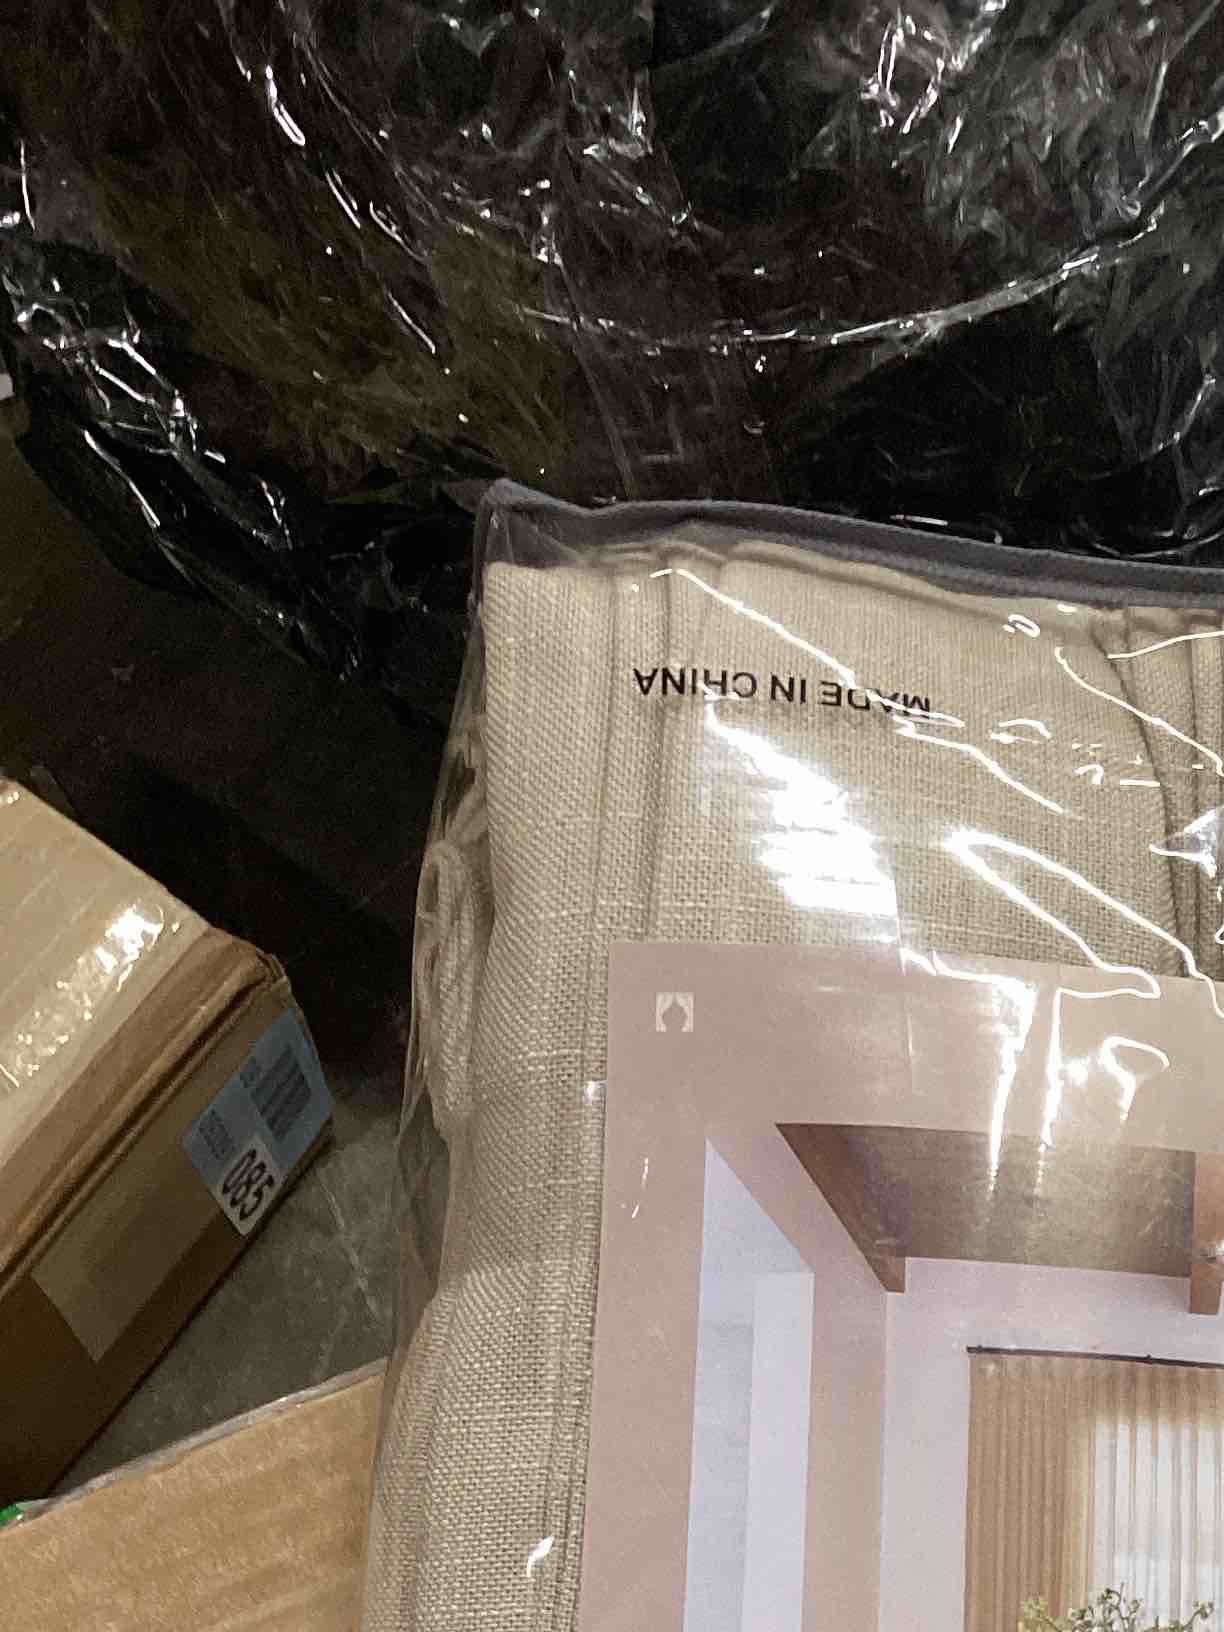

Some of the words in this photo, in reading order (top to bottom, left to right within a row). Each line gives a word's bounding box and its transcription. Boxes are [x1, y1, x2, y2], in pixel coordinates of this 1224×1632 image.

[633, 667, 757, 699] CHINA
[770, 671, 806, 703] IN
[821, 681, 930, 719] MADE
